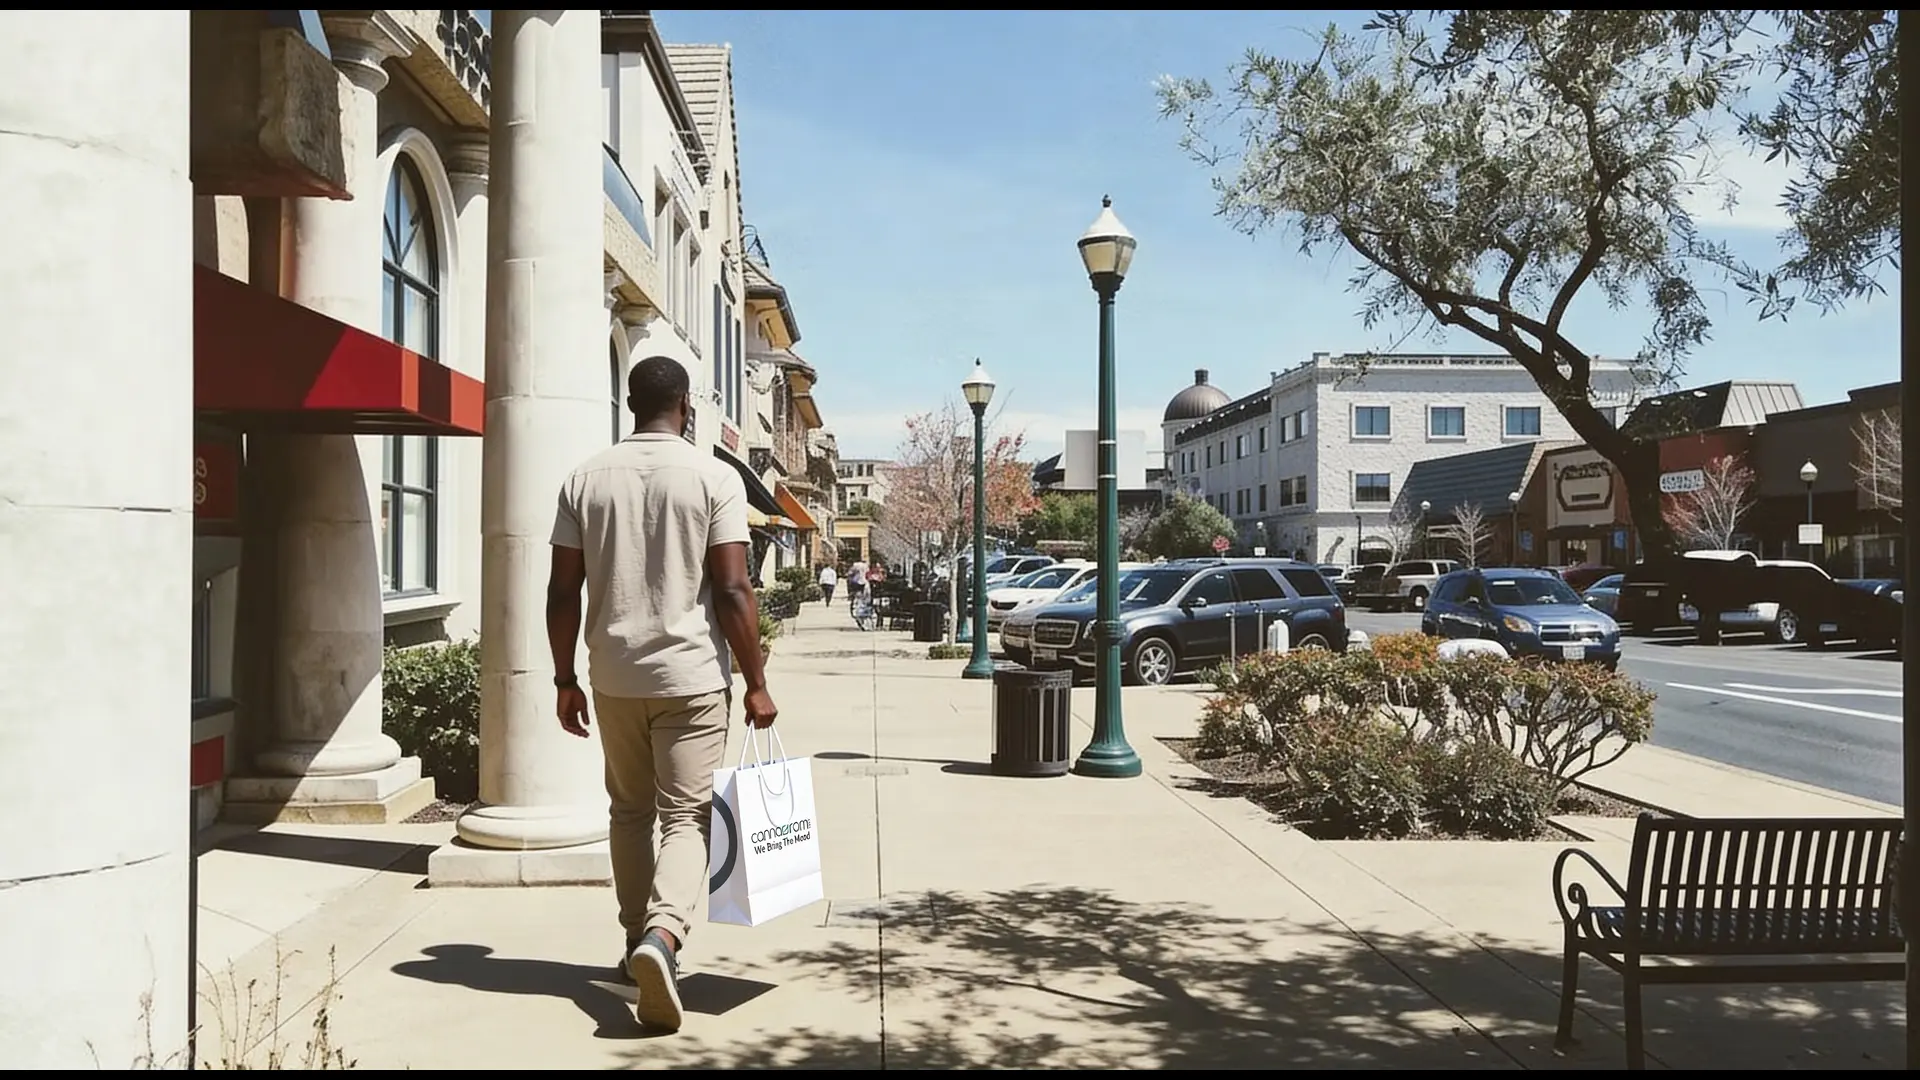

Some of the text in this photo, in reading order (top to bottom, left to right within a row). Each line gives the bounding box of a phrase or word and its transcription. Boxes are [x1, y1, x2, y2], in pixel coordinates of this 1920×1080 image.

[754, 831, 811, 855] We Bring The Mood
